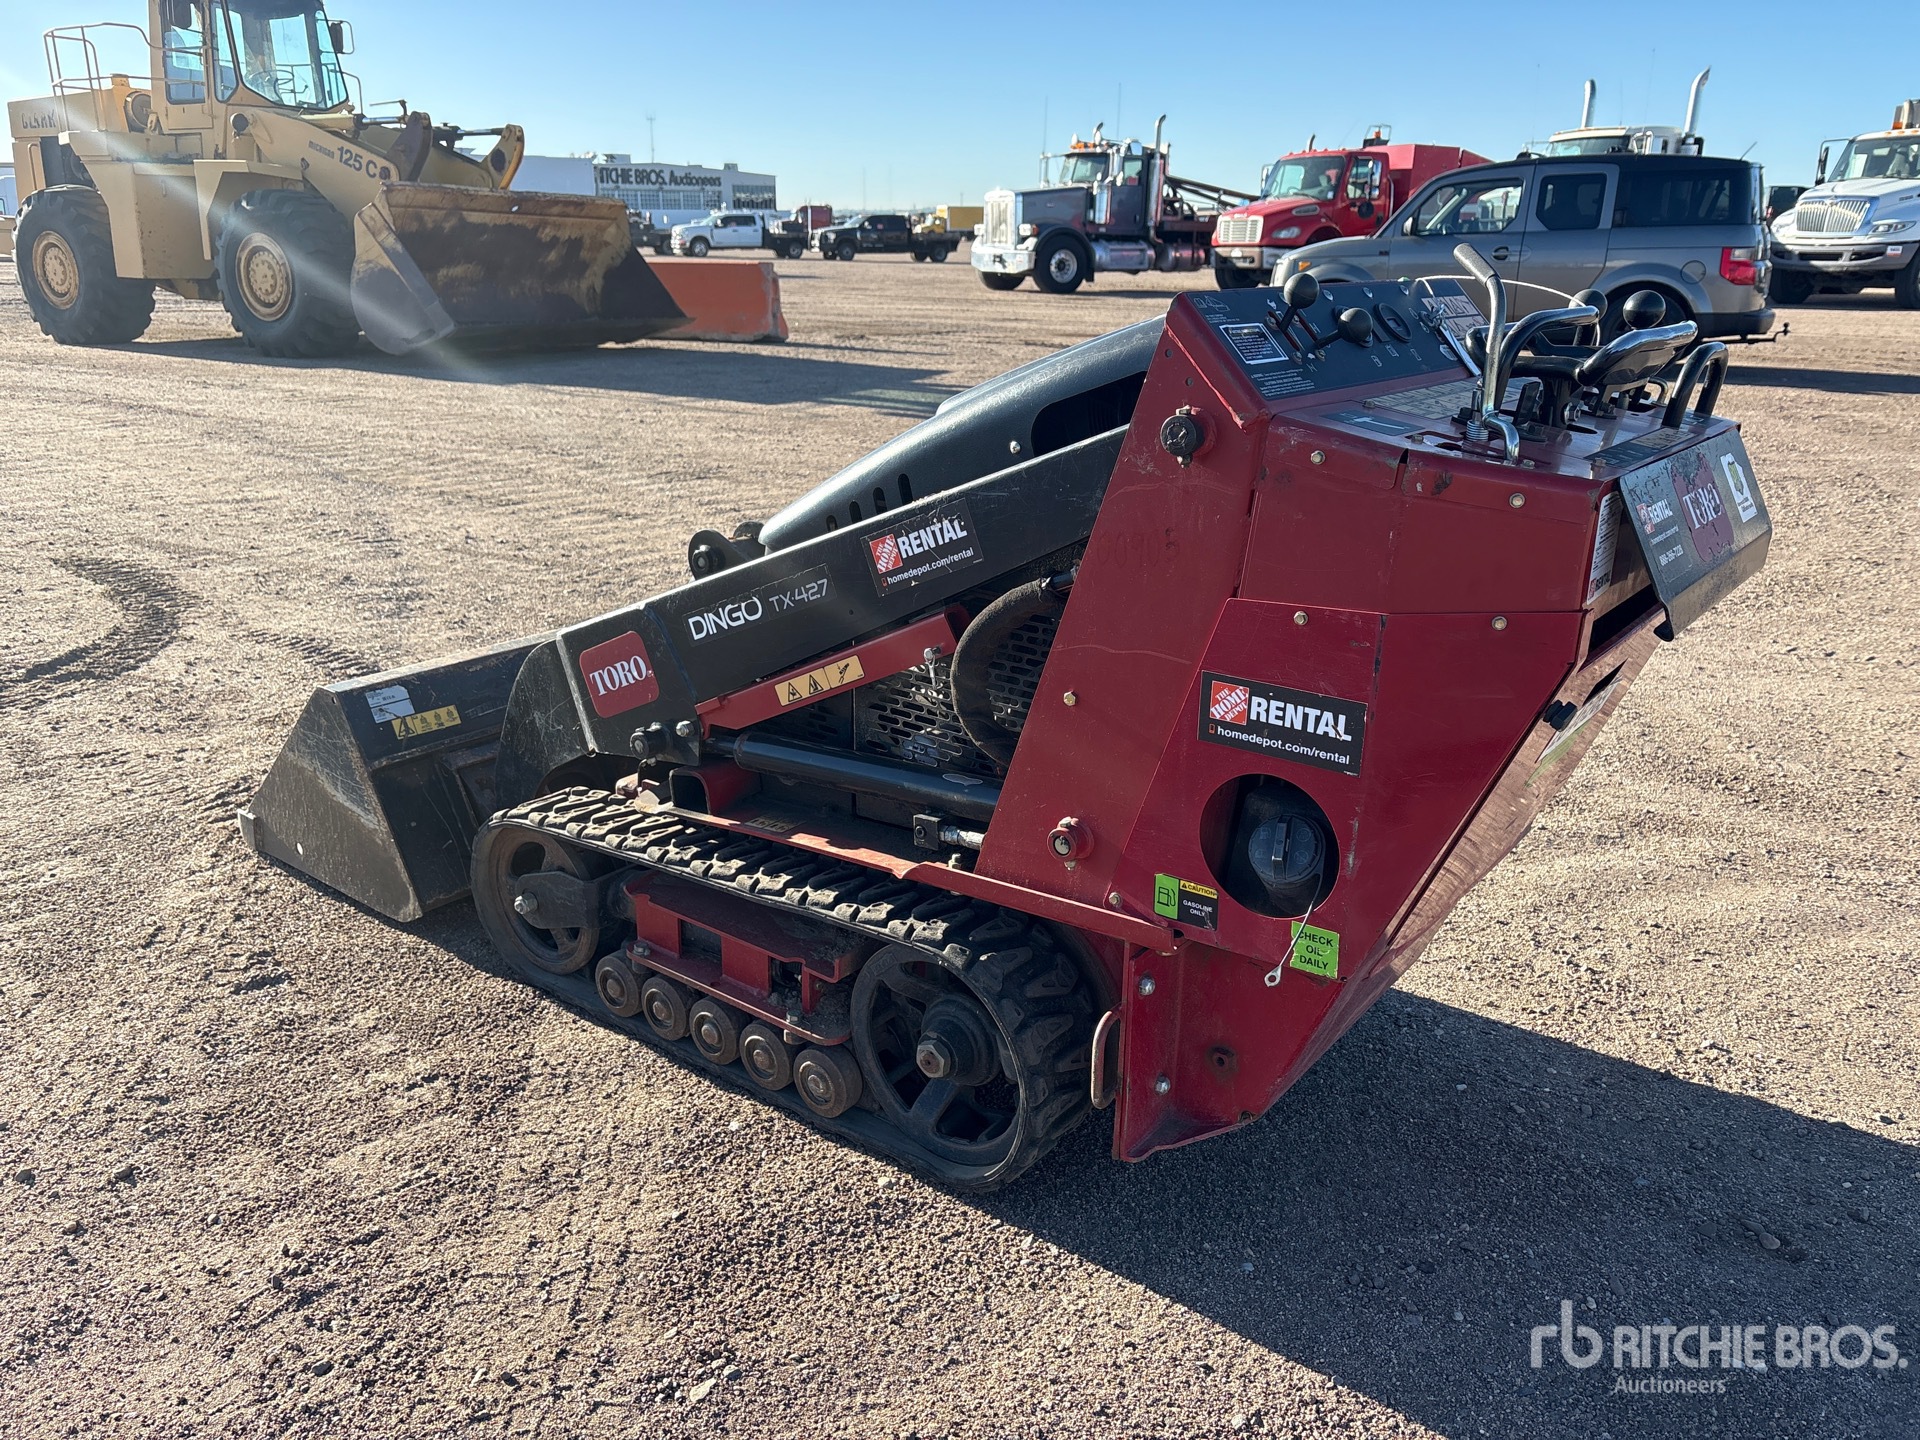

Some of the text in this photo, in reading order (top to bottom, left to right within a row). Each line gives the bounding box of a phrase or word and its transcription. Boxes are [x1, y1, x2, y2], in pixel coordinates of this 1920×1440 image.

[337, 146, 363, 172] 125
[669, 170, 722, 187] Auctioneers
[897, 519, 967, 559] RENTAL
[877, 535, 896, 572] HOME
[887, 547, 974, 585] homedepot.com/rental
[688, 596, 763, 640] DINGO
[590, 655, 648, 696] TORO
[1210, 686, 1248, 719] HOME
[1215, 687, 1231, 701] THE
[1224, 701, 1248, 721] DEPOT
[1250, 696, 1352, 741] RENTAL
[1218, 726, 1350, 765] homedepot.com/rental
[1188, 884, 1216, 897] CAUTION
[1182, 900, 1213, 912] GASOLINE
[1190, 909, 1205, 917] ONLY
[1299, 931, 1333, 947] CHECK
[1300, 955, 1328, 970] DAILY
[1306, 945, 1323, 957] OIL
